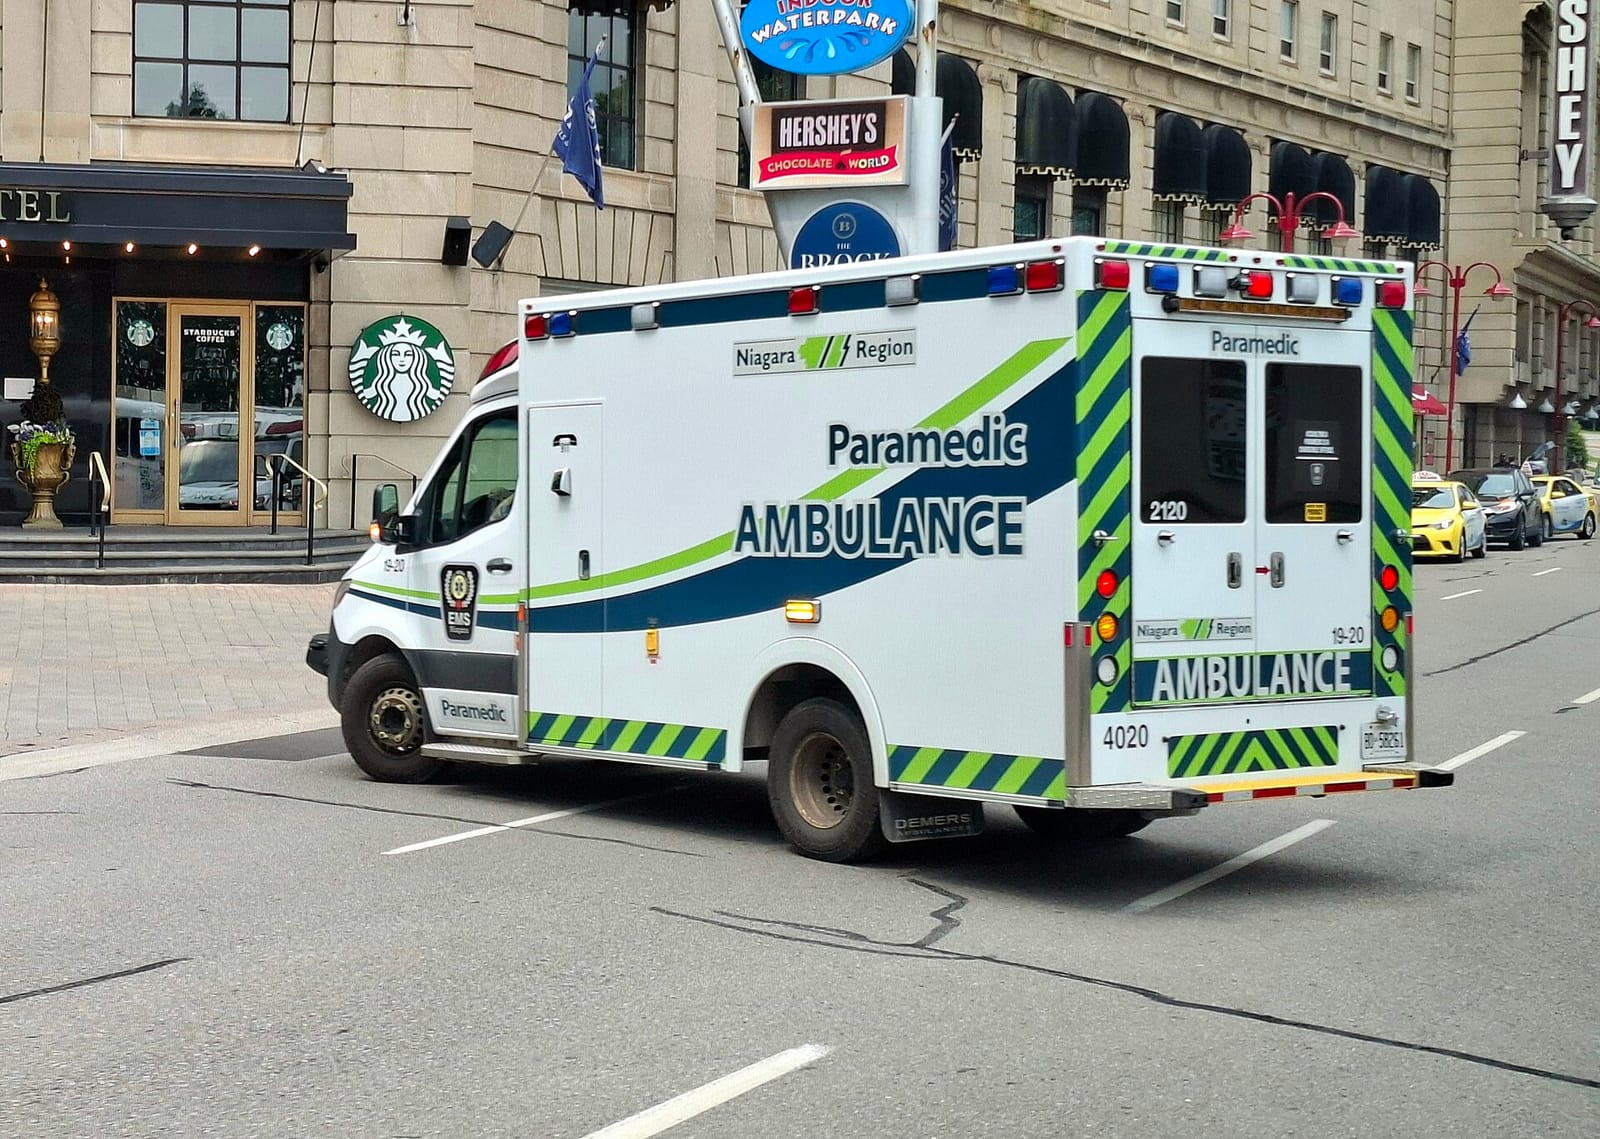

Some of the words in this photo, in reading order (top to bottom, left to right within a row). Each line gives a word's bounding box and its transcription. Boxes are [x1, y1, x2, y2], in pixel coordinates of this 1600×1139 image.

[752, 9, 898, 43] WATERPARK
[779, 112, 878, 148] HERSHEY'S
[767, 158, 833, 173] CHOCOLATE
[848, 155, 890, 169] WORLD
[840, 221, 850, 232] B
[183, 328, 235, 337] STARBUCKS
[1212, 330, 1299, 356] Paramedic
[736, 347, 795, 370] Niagara
[856, 339, 914, 360] Region
[828, 412, 1028, 467] Paramedic
[1149, 500, 1188, 521] 2120
[733, 495, 1026, 560] AMBULANCE
[448, 611, 471, 626] EMS
[1136, 623, 1179, 640] Niagara
[1216, 622, 1251, 638] Region
[1332, 625, 1365, 645] 19-20
[1152, 652, 1351, 701] AMBULANCE
[441, 697, 507, 724] Paramedic
[1103, 724, 1149, 750] 4020
[894, 814, 970, 829] DEMERS
